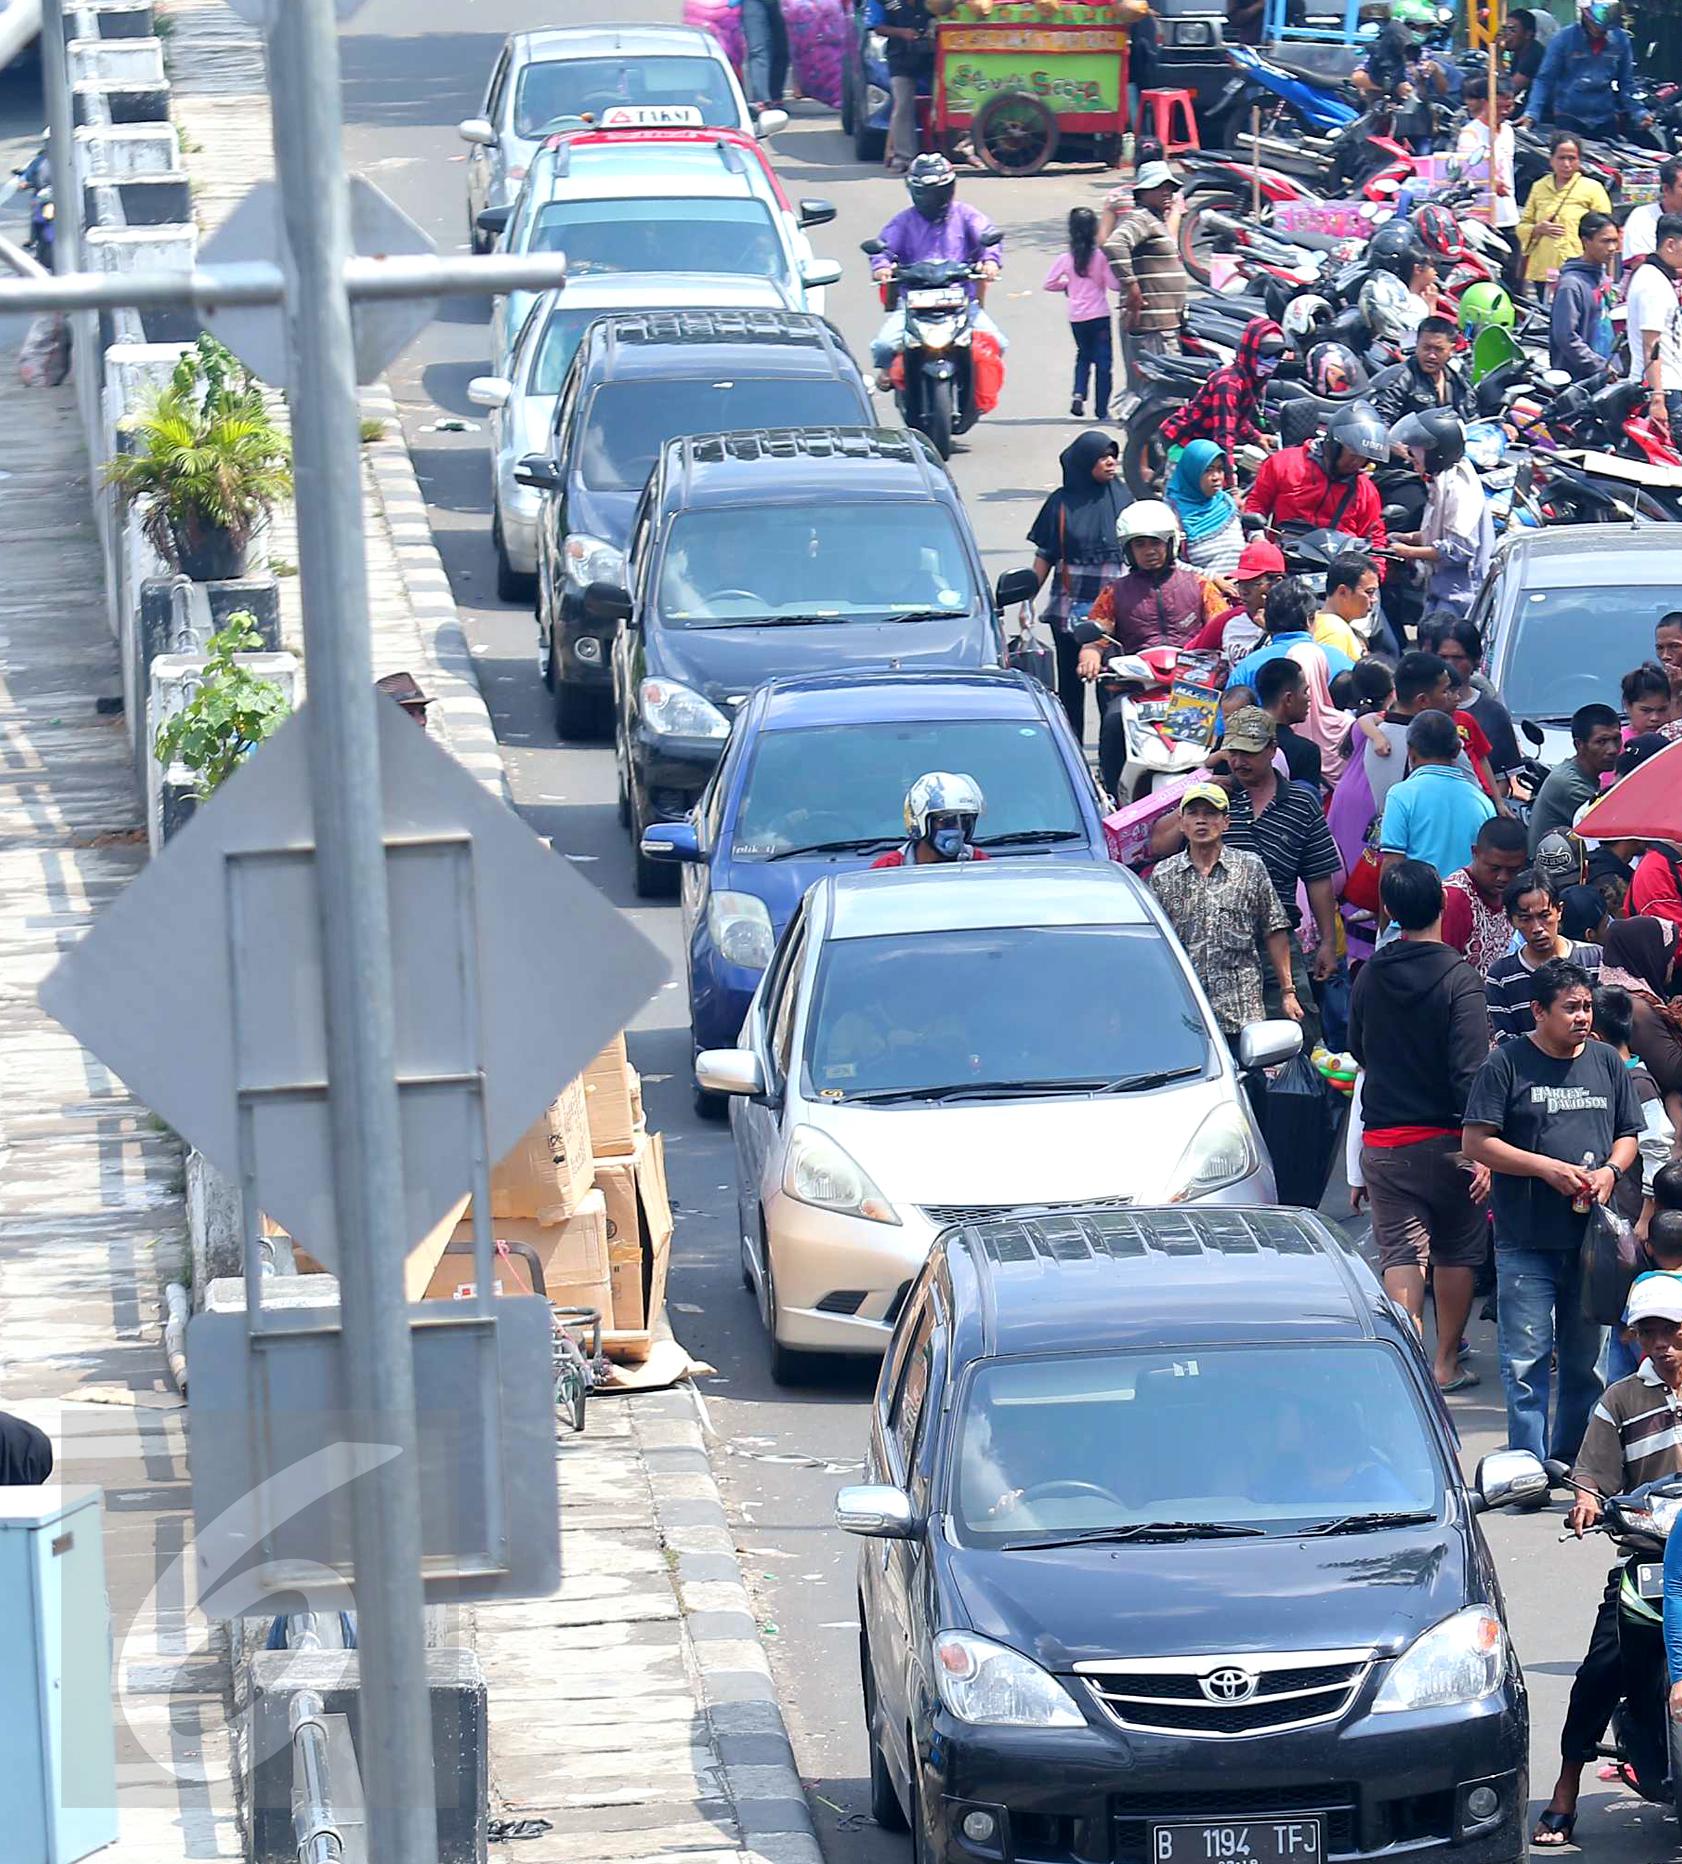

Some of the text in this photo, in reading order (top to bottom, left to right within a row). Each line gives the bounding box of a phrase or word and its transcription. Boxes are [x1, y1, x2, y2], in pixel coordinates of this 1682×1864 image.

[1547, 1096, 1608, 1114] DAVIDSON
[1157, 1824, 1318, 1860] B 1194 TFJ
